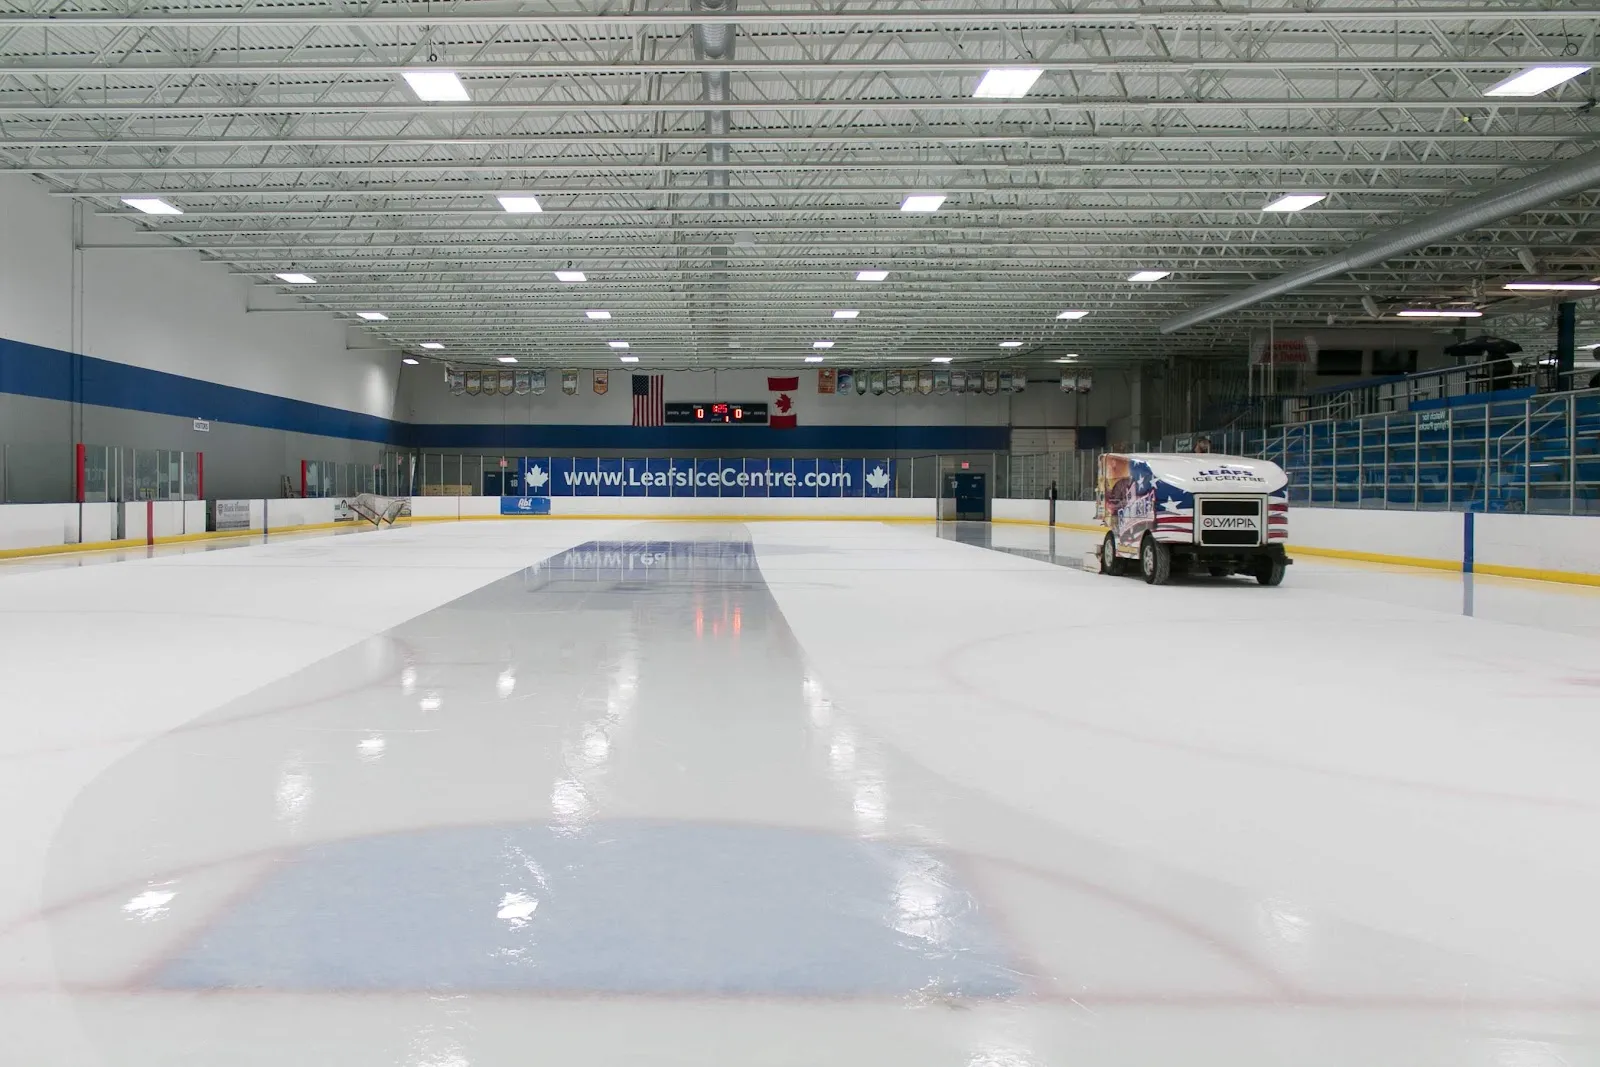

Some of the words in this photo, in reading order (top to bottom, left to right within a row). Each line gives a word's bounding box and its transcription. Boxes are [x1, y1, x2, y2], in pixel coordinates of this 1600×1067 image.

[563, 467, 852, 486] www.LeafsIceCentre.com
[1215, 475, 1265, 483] CENTRE
[518, 498, 532, 508] Abt
[1203, 517, 1256, 528] OLYMPIA
